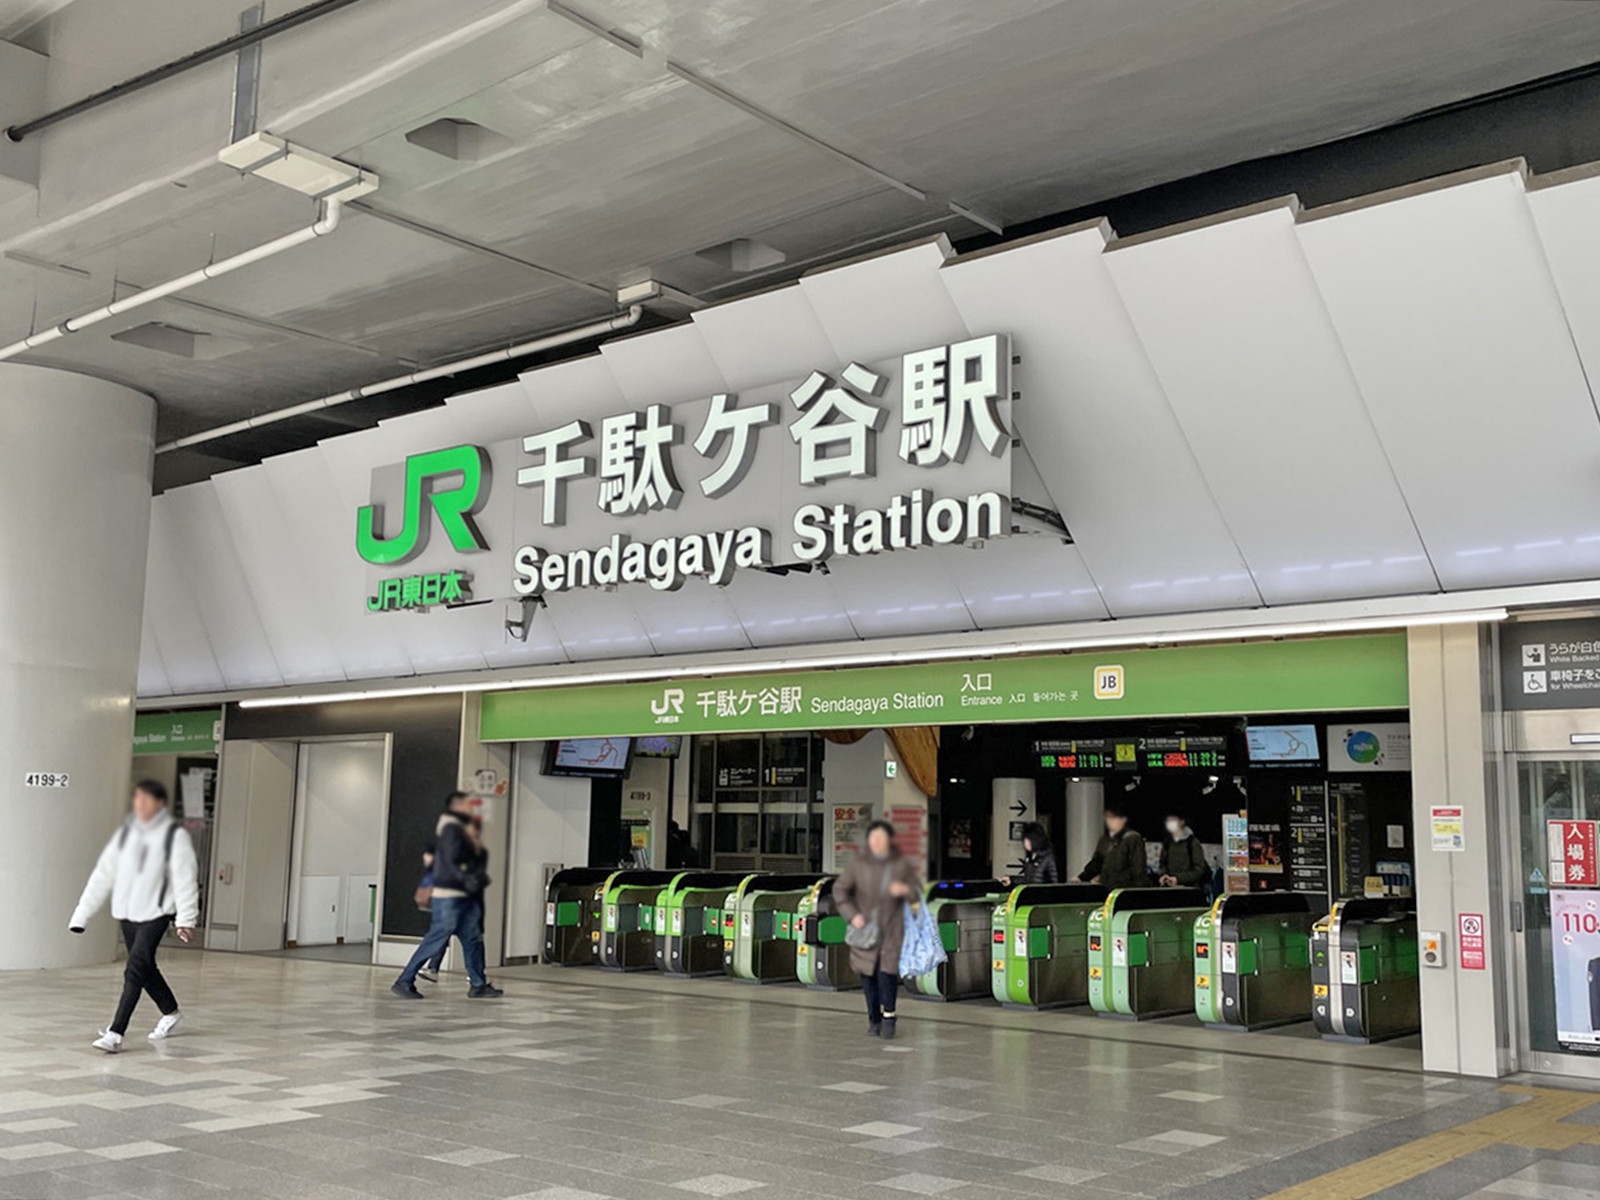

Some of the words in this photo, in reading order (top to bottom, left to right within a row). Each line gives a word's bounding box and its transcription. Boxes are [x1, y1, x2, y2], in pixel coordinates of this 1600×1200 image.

[516, 334, 1012, 527] 千駄ケ谷駅
[355, 444, 490, 565] JR
[513, 524, 766, 594] Sendagaya
[793, 488, 1004, 562] Station
[366, 569, 466, 612] JR東日本
[961, 673, 993, 692] 入口
[1101, 675, 1117, 689] JB
[651, 688, 685, 715] JR
[696, 686, 802, 719] 千駄ケ谷駅
[811, 696, 889, 715] Sendagaya
[893, 692, 944, 709] Station
[961, 694, 1003, 706] Entrance
[1009, 693, 1026, 703] 入口
[26, 774, 69, 787] 4199-2
[1566, 822, 1586, 882] 入場券
